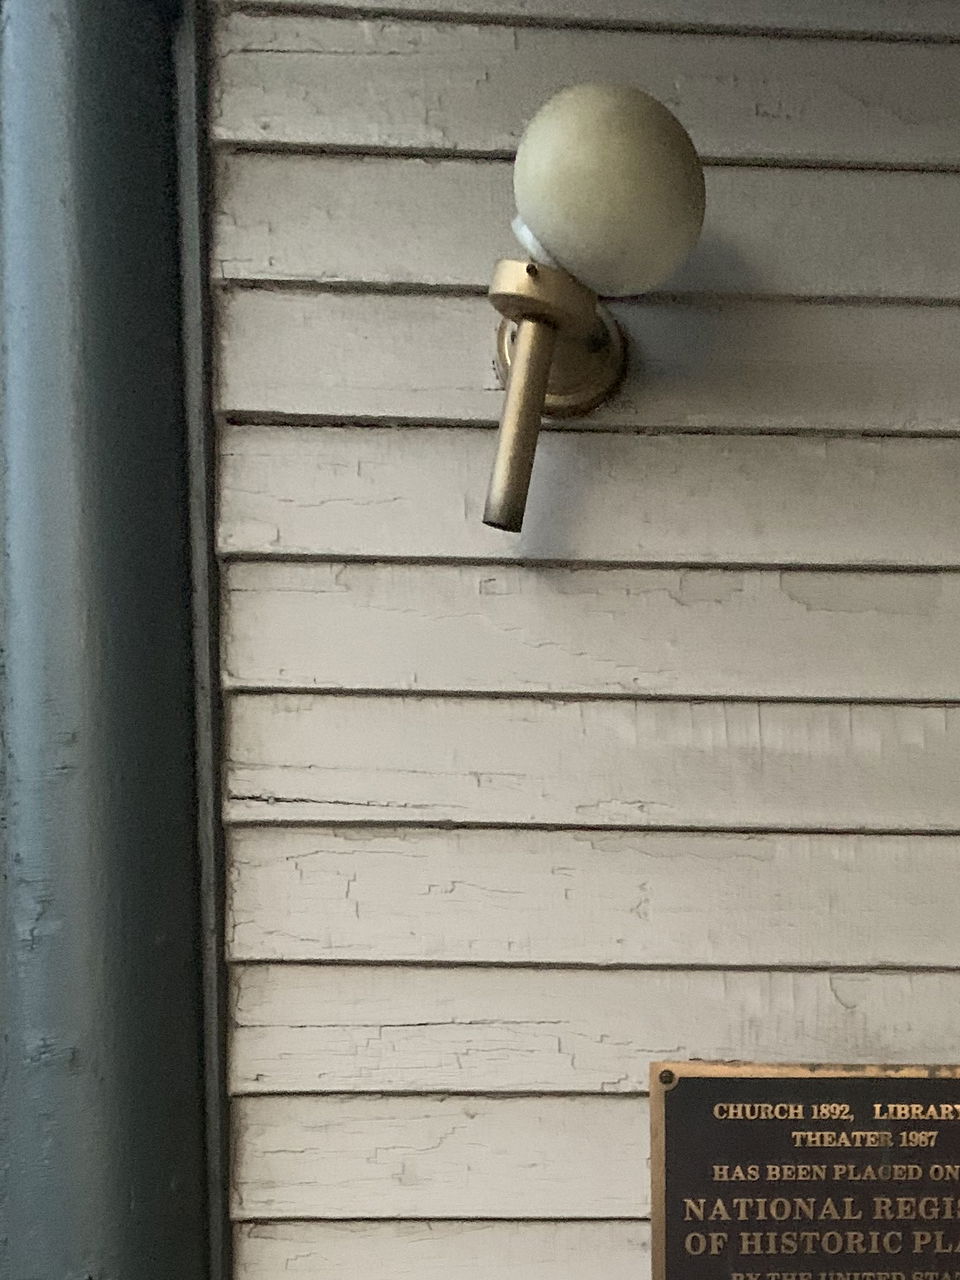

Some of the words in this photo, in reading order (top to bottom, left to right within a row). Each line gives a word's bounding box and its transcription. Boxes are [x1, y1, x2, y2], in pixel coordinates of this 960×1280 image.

[713, 1103, 805, 1120] CHURCH
[811, 1103, 855, 1123] 1892,
[791, 1131, 894, 1148] THEATER
[899, 1131, 939, 1147] 1967
[712, 1165, 760, 1181] HAS
[766, 1165, 827, 1181] BEEN
[833, 1165, 922, 1181] PLACED
[929, 1165, 960, 1181] ON
[683, 1198, 862, 1221] NATIONAL
[684, 1232, 728, 1256] OF
[739, 1231, 901, 1255] HISTORIC
